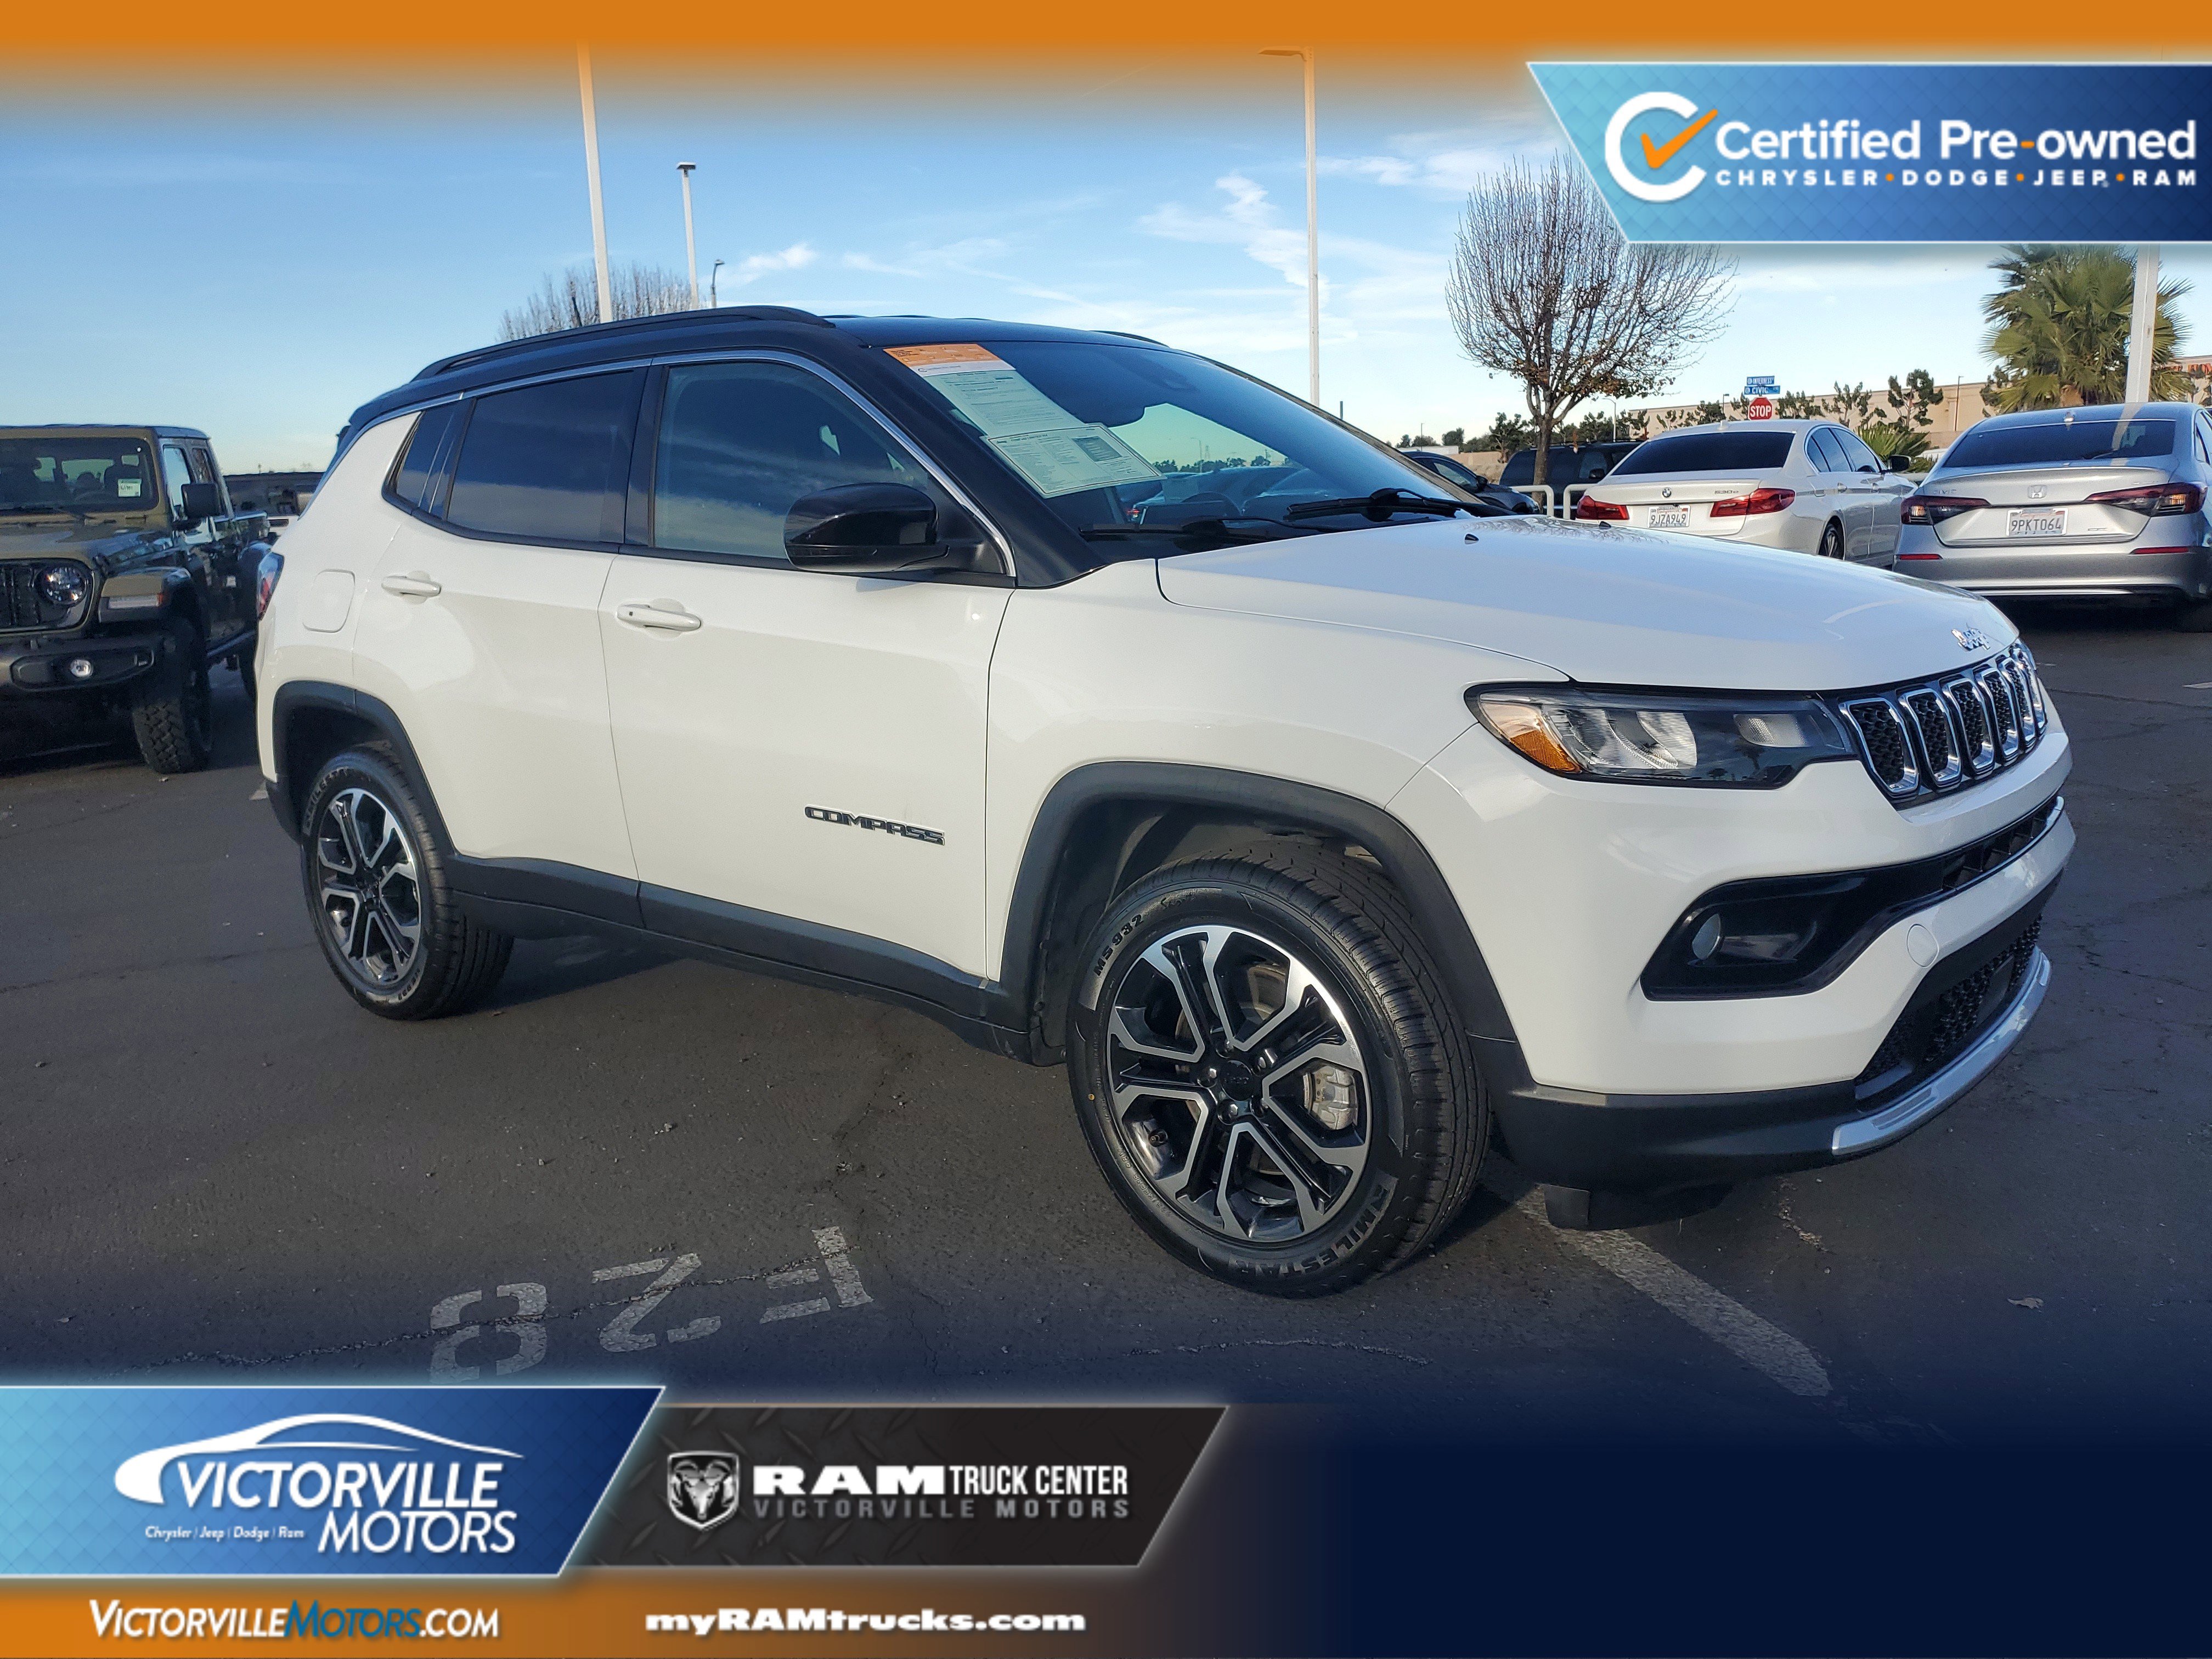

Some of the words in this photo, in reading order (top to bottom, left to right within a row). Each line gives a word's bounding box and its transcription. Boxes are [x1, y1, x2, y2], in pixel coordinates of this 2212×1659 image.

[1750, 405, 1771, 417] STOP
[1651, 514, 1686, 525] 9JZA949
[2012, 518, 2061, 532] 9PKT064
[805, 805, 945, 845] COMPASS
